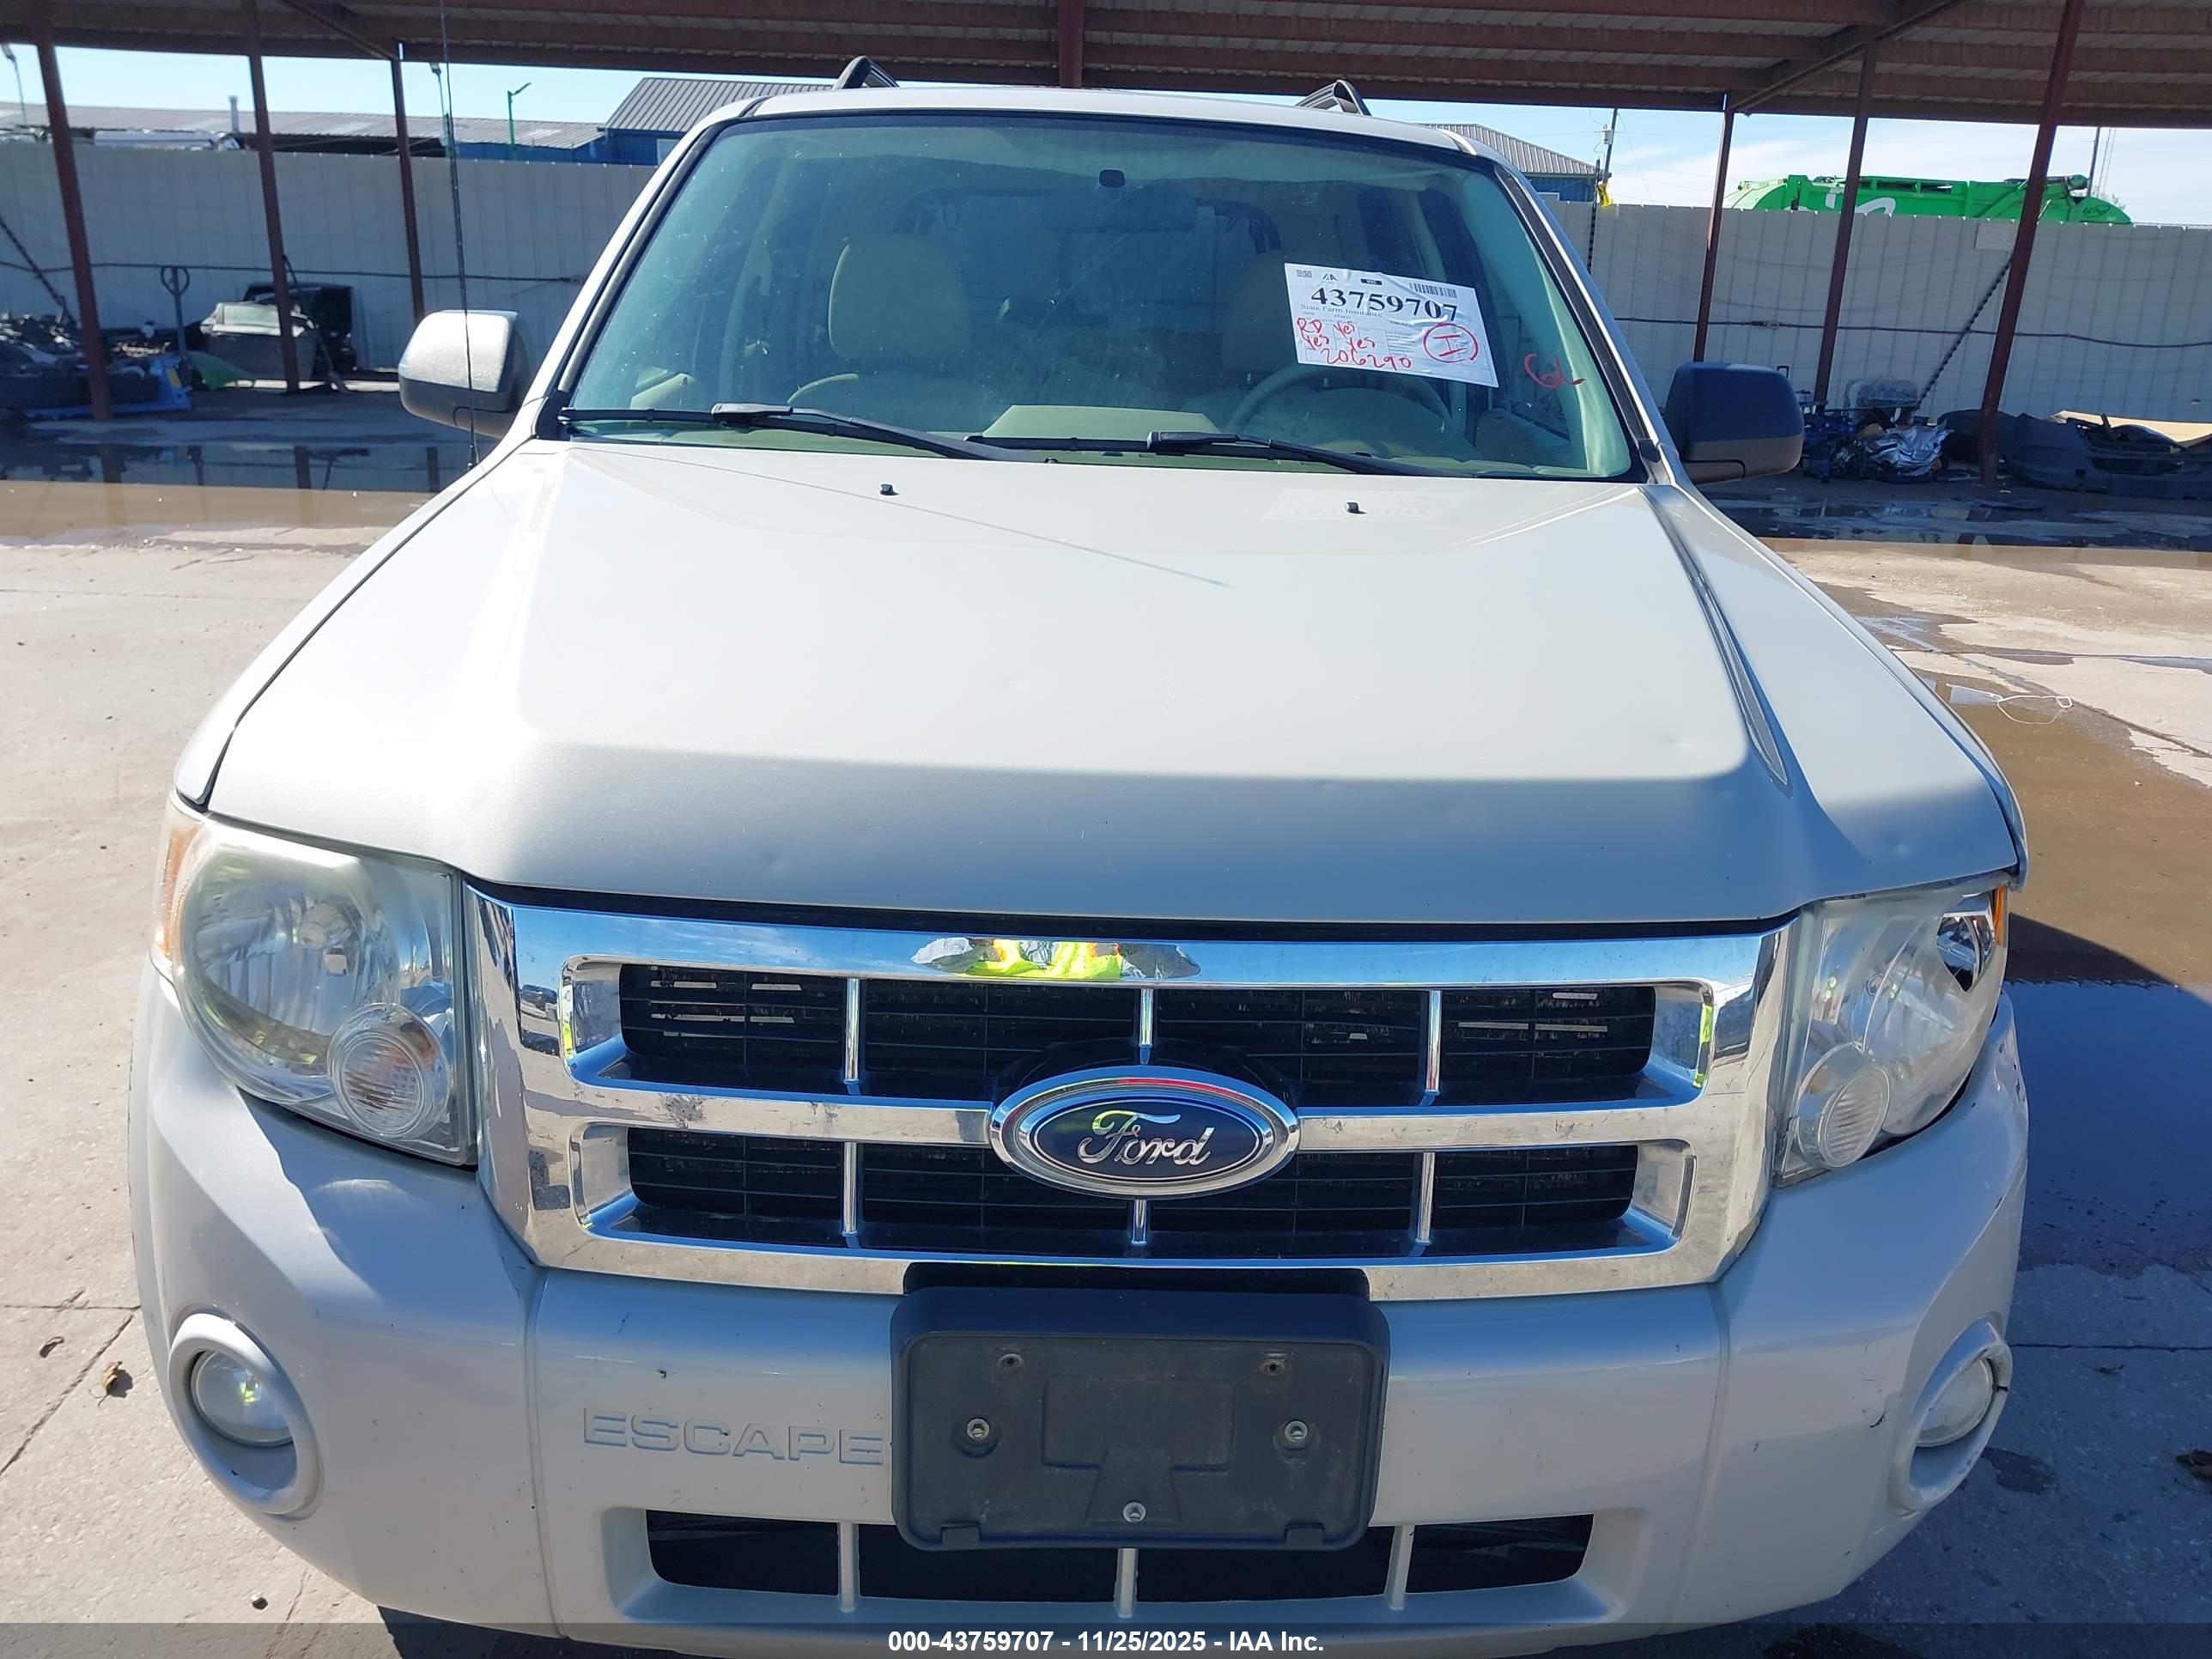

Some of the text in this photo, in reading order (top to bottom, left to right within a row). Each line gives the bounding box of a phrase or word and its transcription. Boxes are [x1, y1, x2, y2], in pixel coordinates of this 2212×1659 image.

[1311, 288, 1457, 321] 43759707
[1077, 1109, 1215, 1166] Ford
[584, 1408, 884, 1466] ESCAPE
